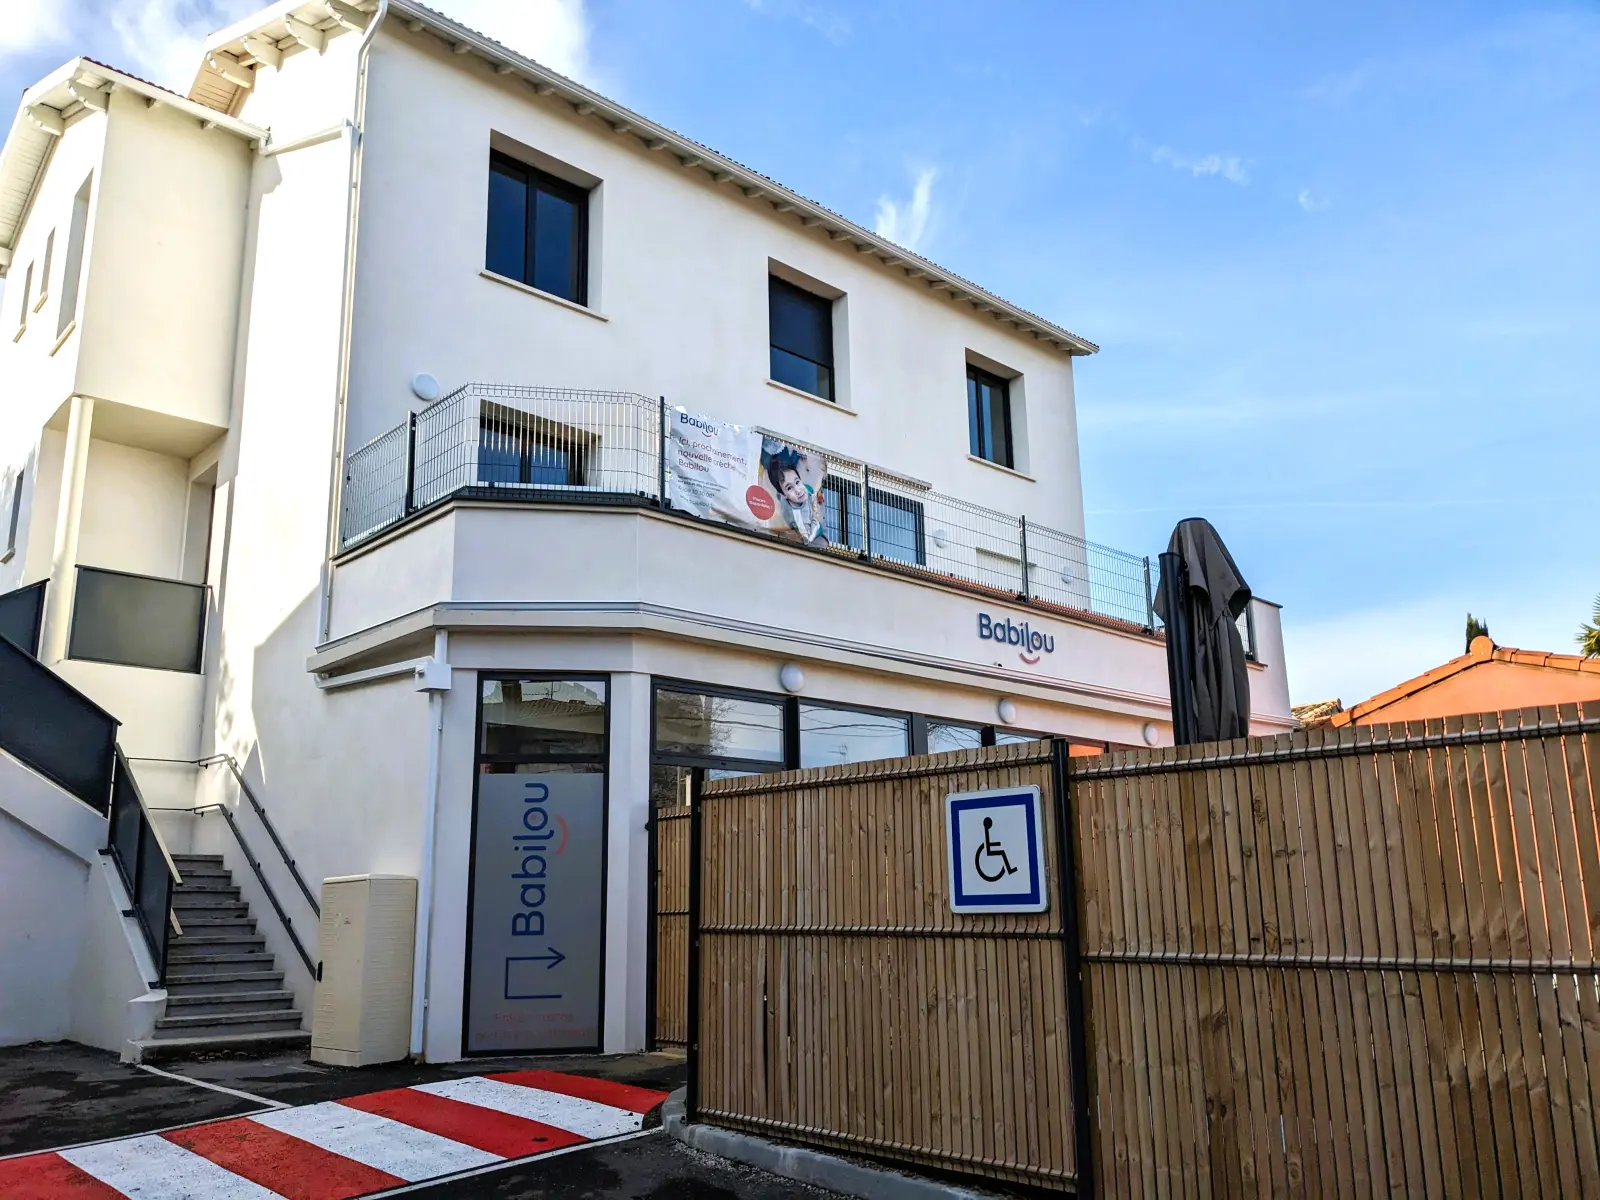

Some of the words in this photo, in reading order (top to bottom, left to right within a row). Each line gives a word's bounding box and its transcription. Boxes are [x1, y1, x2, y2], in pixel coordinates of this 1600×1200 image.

[680, 413, 718, 436] Babilou
[678, 450, 712, 463] nouvelle
[678, 458, 709, 473] Babilou
[978, 612, 1055, 654] Babilou
[511, 782, 555, 936] Babilou
